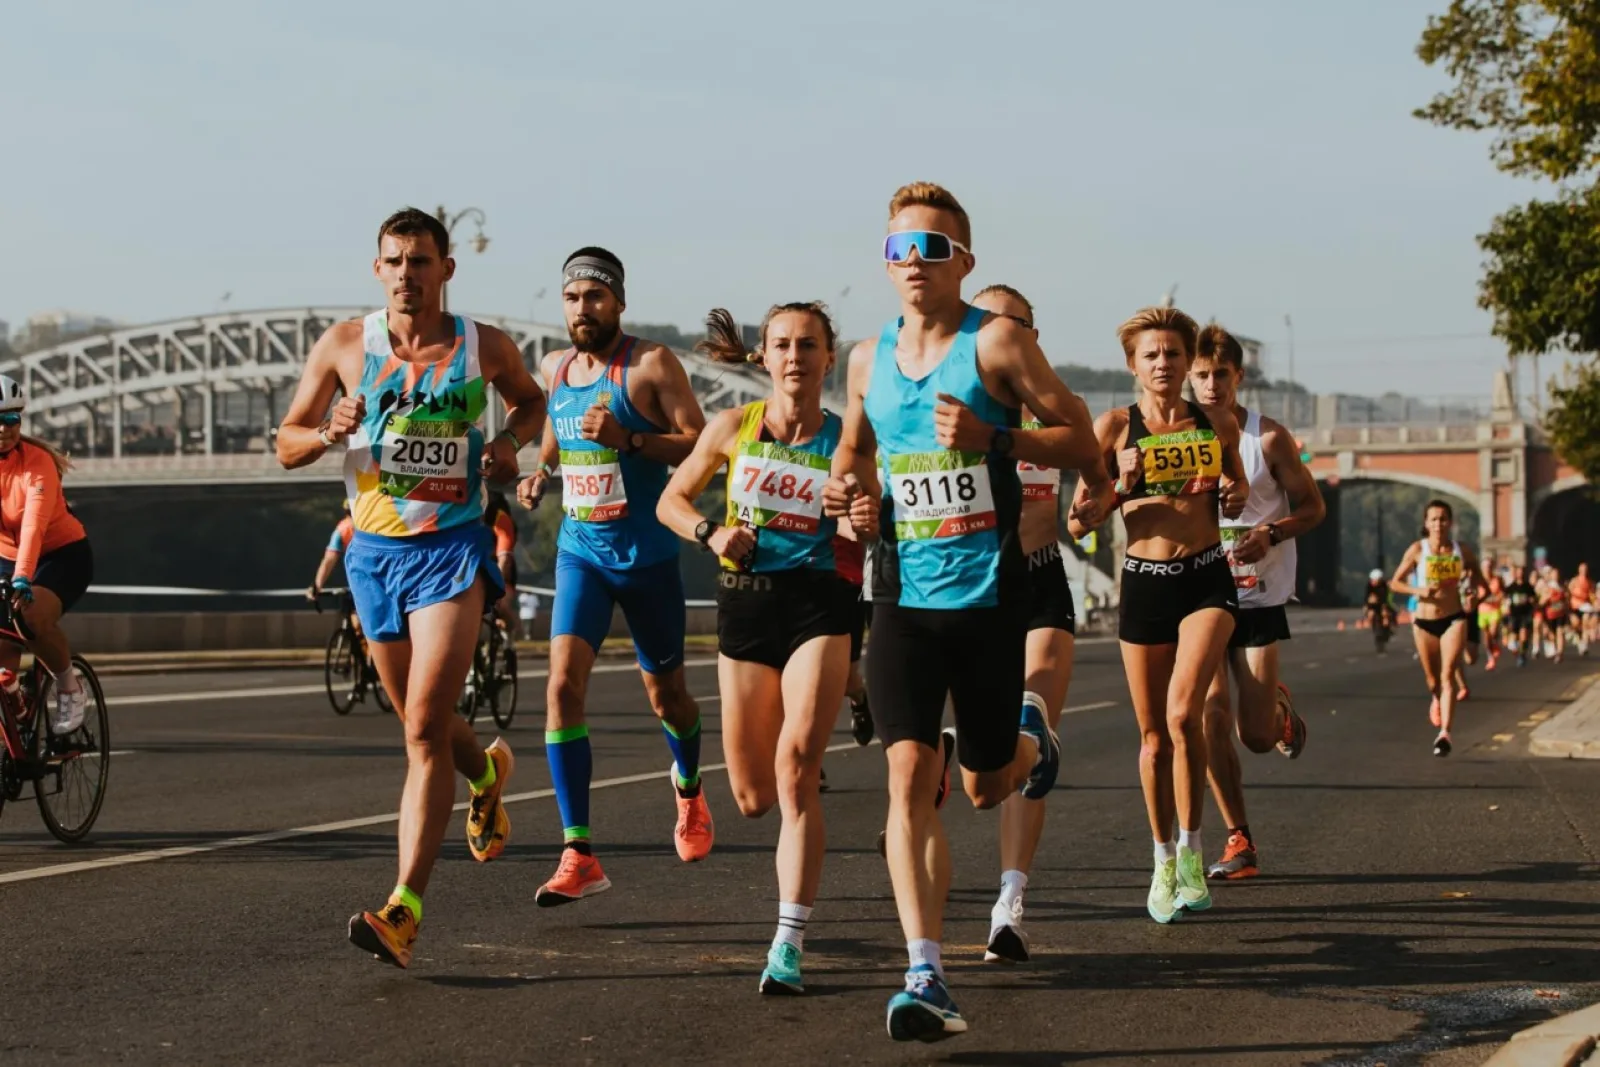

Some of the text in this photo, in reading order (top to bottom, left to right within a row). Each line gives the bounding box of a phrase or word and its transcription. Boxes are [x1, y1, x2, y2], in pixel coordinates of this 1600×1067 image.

[574, 268, 613, 284] TERREX
[392, 439, 458, 466] 2030
[1153, 443, 1213, 470] 5315
[400, 465, 449, 476] ВЛАДИМИР
[566, 473, 613, 496] 7587
[743, 466, 815, 505] 7484
[902, 473, 976, 506] 3118
[570, 508, 577, 517] A
[741, 506, 750, 519] A
[1139, 562, 1184, 576] PRO
